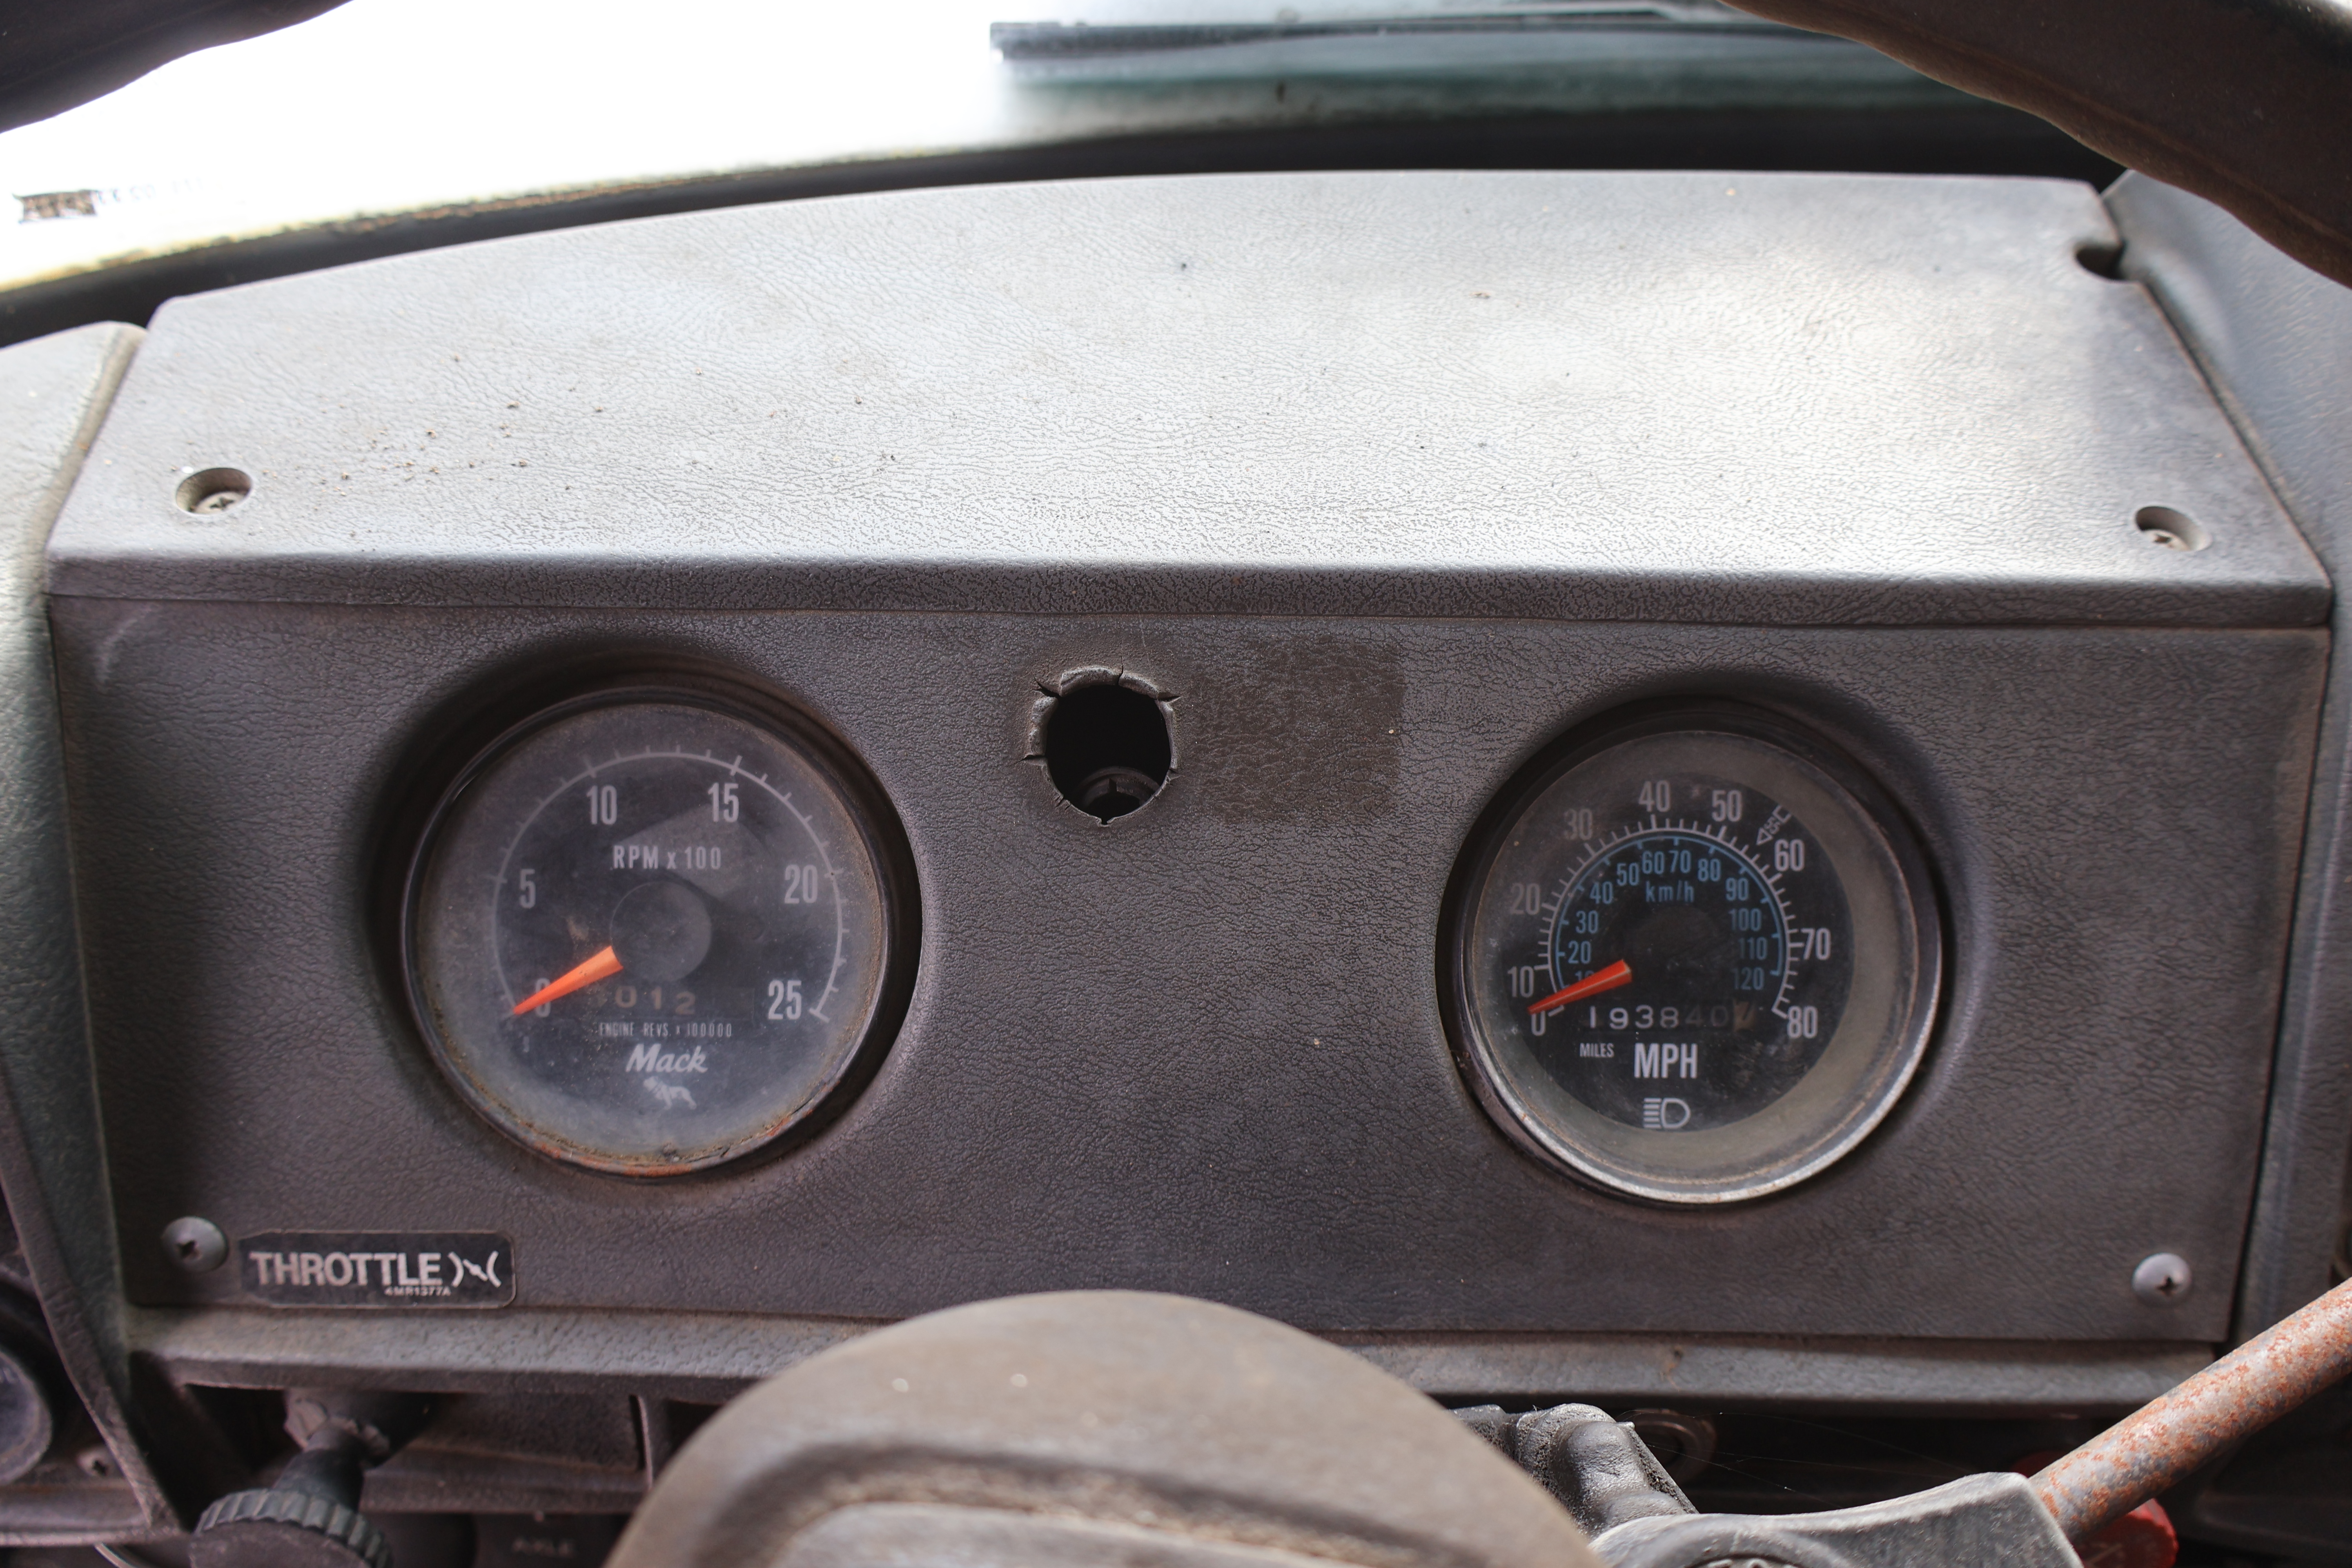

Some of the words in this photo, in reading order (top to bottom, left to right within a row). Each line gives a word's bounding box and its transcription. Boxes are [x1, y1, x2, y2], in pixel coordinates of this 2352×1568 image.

[587, 785, 617, 825] 10
[708, 782, 739, 822] 15
[1638, 780, 1671, 812] 40
[1711, 789, 1743, 822] 50
[1563, 808, 1593, 841] 30
[613, 845, 658, 869] RPM
[684, 846, 722, 870] 100
[1642, 851, 1664, 875] 60
[1668, 850, 1692, 874] 70
[1774, 838, 1805, 872] 60
[784, 864, 818, 904] 20
[1616, 862, 1639, 886] 50
[1697, 858, 1722, 882] 80
[519, 868, 535, 908] 5
[1510, 882, 1541, 915] 20
[1589, 881, 1613, 904] 40
[1646, 880, 1694, 902] km/h
[1726, 878, 1749, 901] 90
[1575, 910, 1599, 934] 30
[1729, 907, 1762, 931] 100
[1568, 940, 1592, 964] 20
[1738, 937, 1768, 960] 110
[1801, 927, 1832, 960] 70
[1507, 965, 1535, 998] 10
[1732, 967, 1764, 991] 120
[768, 980, 802, 1020] 25
[599, 1022, 634, 1037] ENGINE
[686, 1022, 732, 1038] 100000
[1531, 1010, 1546, 1036] 0
[1786, 1005, 1818, 1039] 80
[626, 1043, 708, 1073] Mack
[1579, 1042, 1615, 1058] MILES
[1633, 1042, 1698, 1079] MPH
[249, 1251, 443, 1286] THROTTLE
